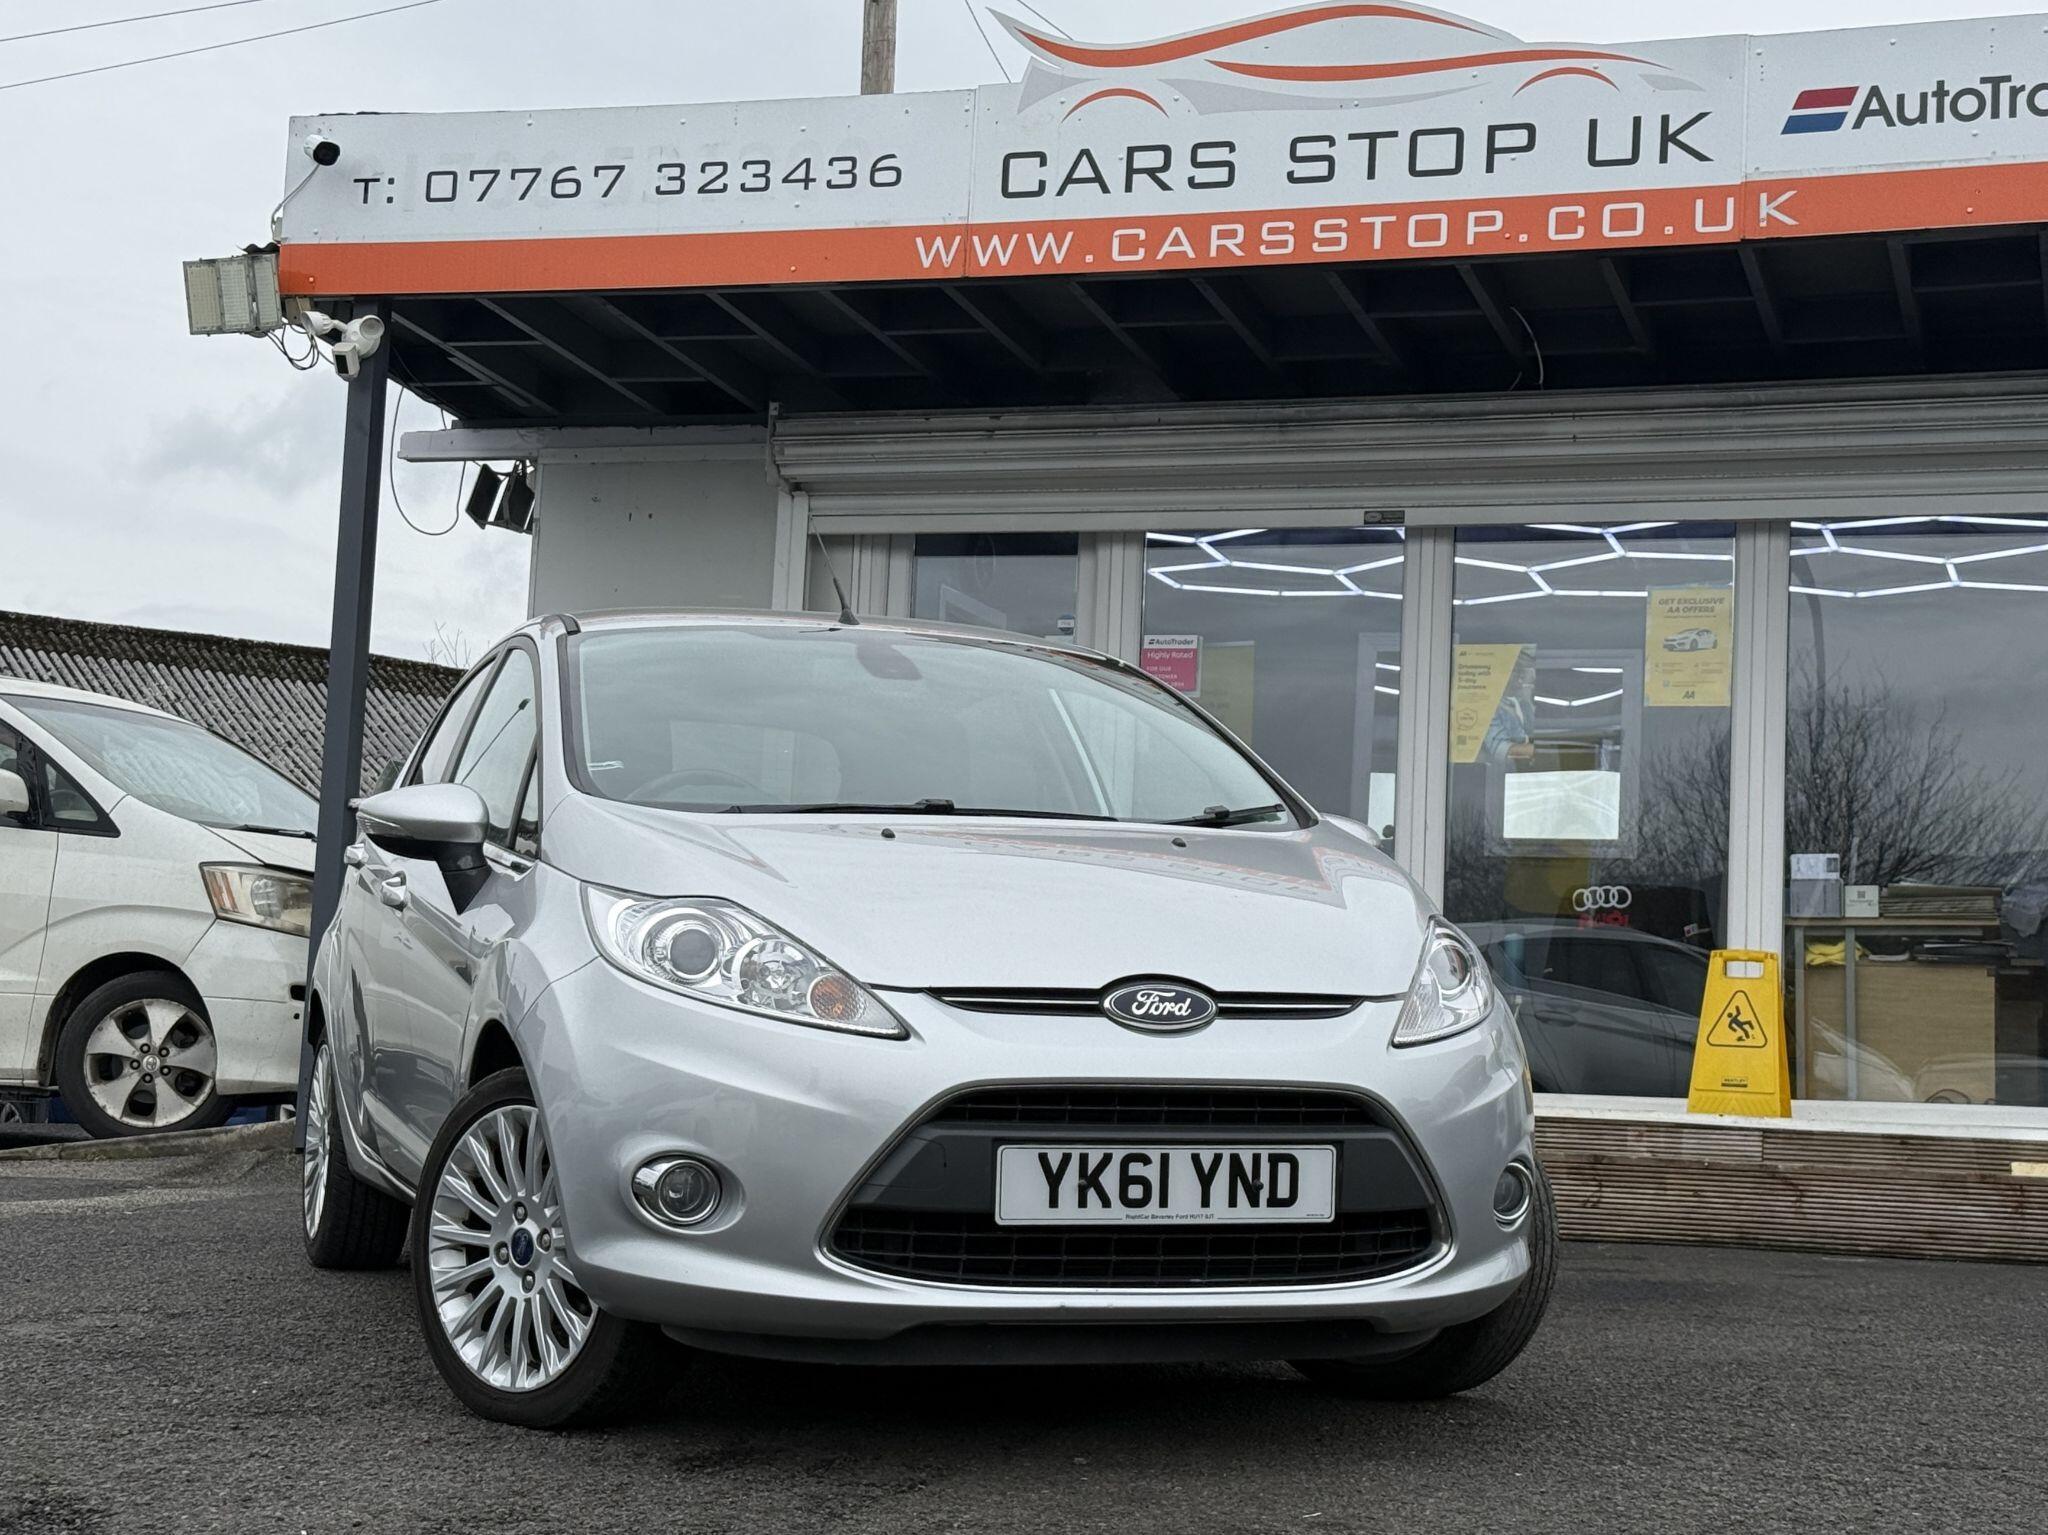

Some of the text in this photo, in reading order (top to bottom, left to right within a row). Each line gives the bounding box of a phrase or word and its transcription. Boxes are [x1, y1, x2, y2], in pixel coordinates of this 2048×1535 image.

[1000, 111, 1715, 199] CARS STOP UK
[353, 154, 903, 205] T: 07767 323436
[915, 190, 1800, 269] WWW.CARSSTOP.CO.UK
[1677, 597, 1725, 605] EXCLUSIVE
[1682, 605, 1715, 613] OFFERS
[1155, 638, 1194, 646] AutoTrader
[1147, 651, 1193, 660] Highly Rated
[1682, 690, 1695, 700] AA
[1131, 990, 1192, 1017] Ford
[1038, 1152, 1300, 1209] YK61 YND
